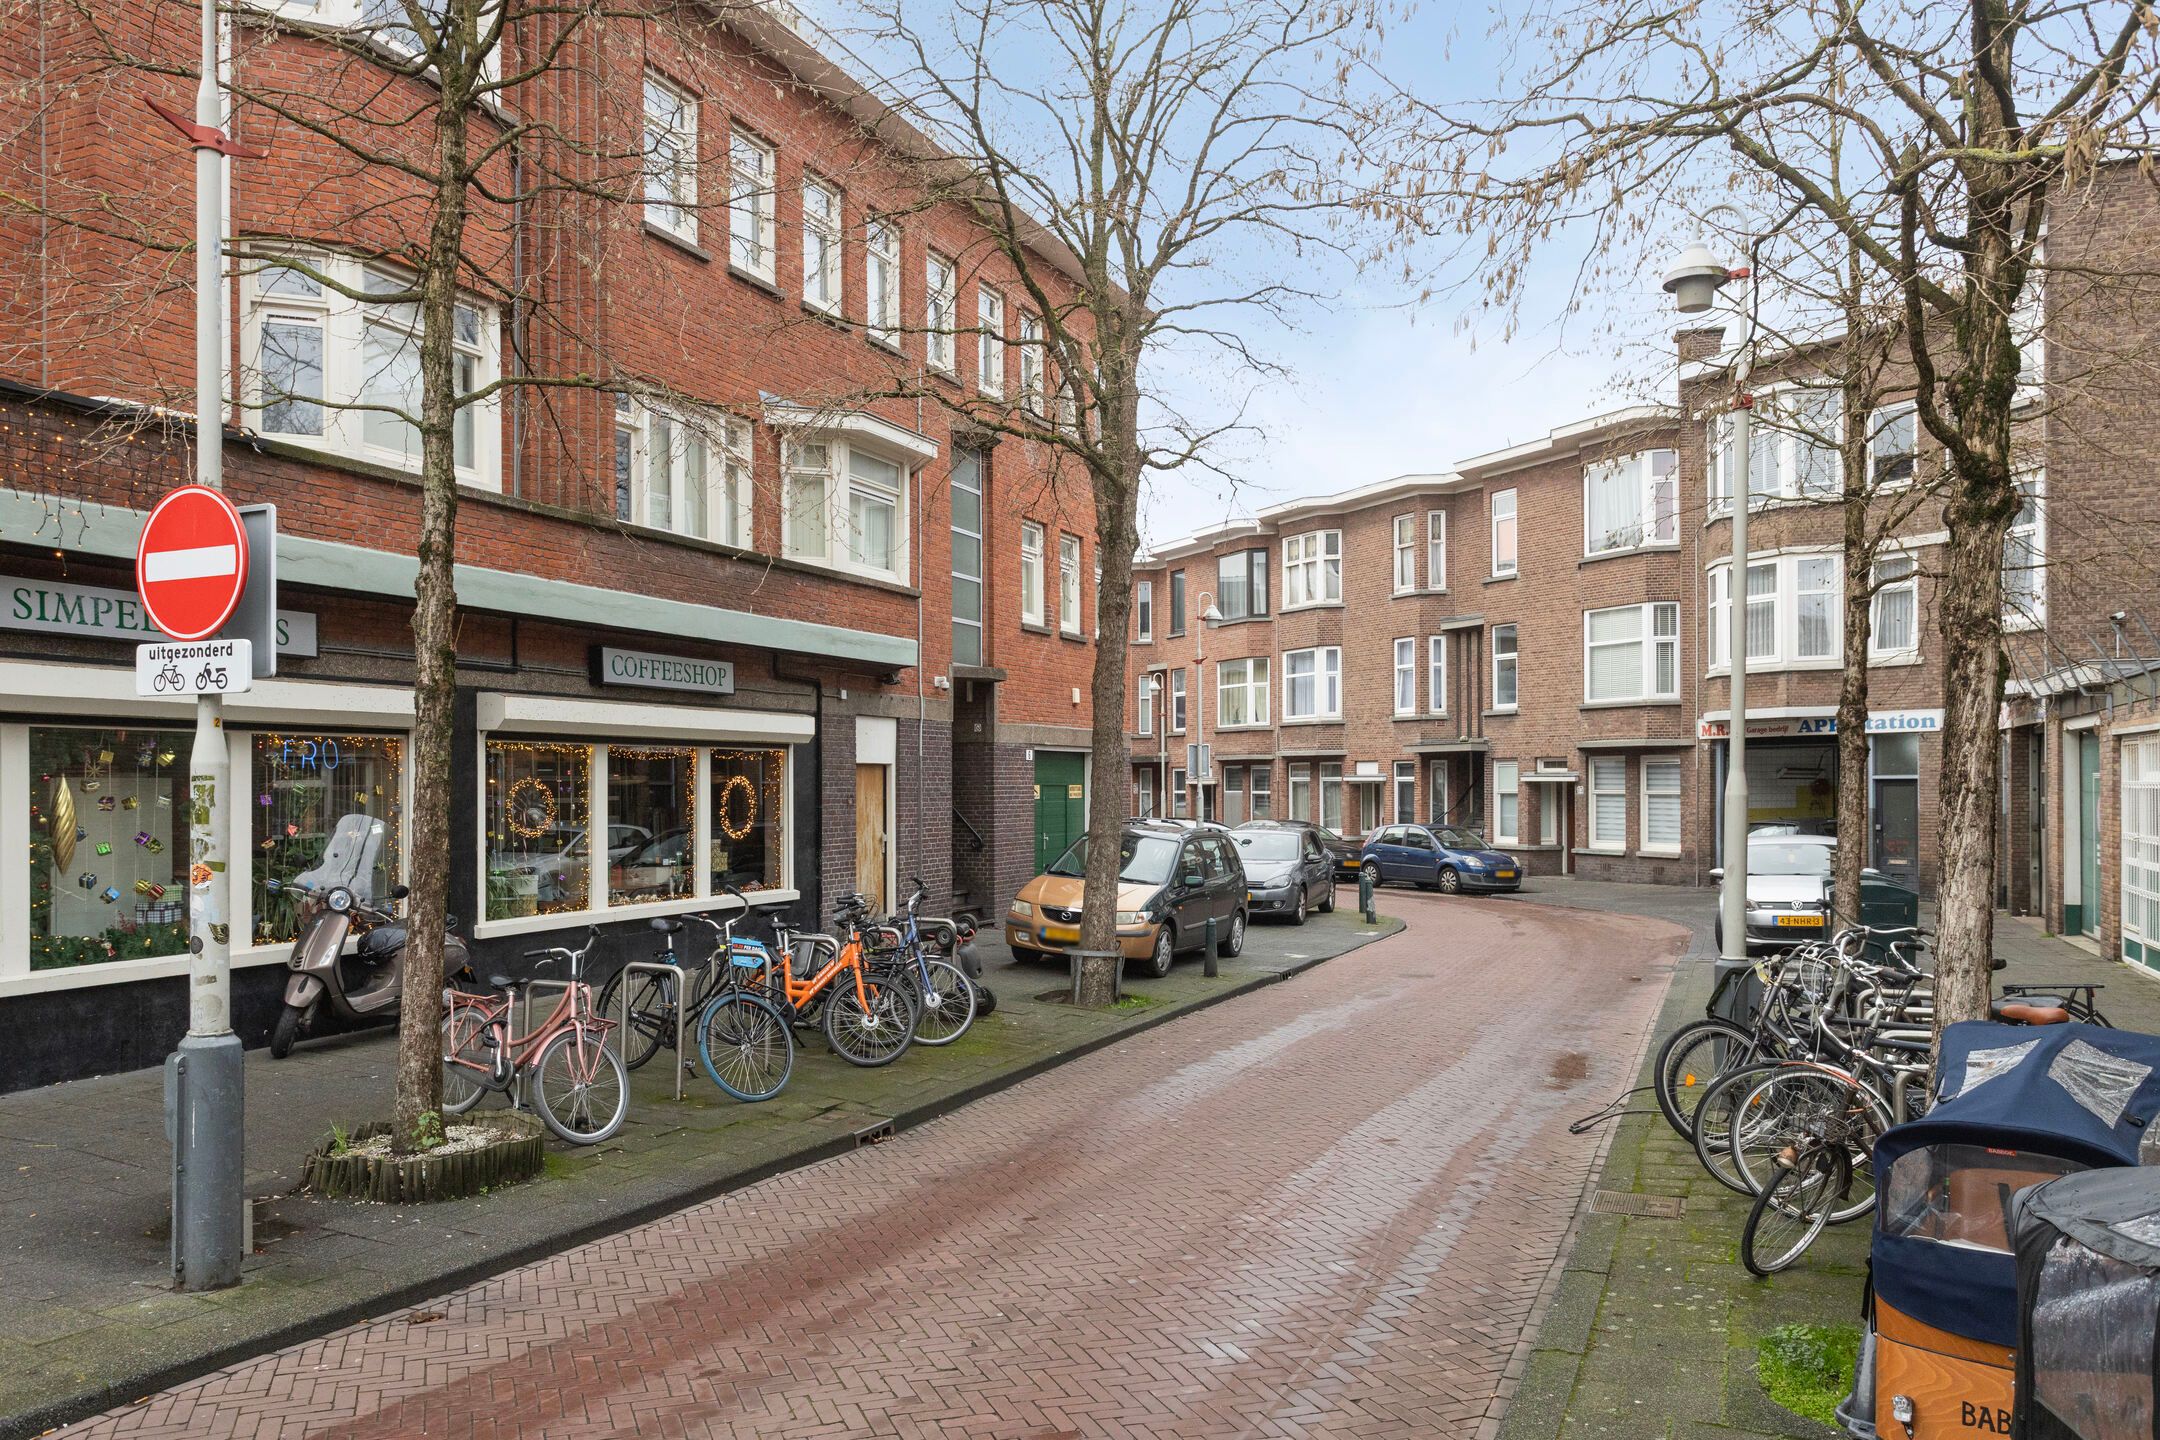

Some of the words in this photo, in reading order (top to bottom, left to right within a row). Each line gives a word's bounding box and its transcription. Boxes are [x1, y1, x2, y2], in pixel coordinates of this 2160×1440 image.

[149, 642, 233, 664] uitgezonderd
[611, 654, 727, 687] COFFEESHOP
[1746, 726, 1768, 735] Garage
[1865, 714, 1936, 730] tation
[1961, 1400, 2012, 1435] BAB
